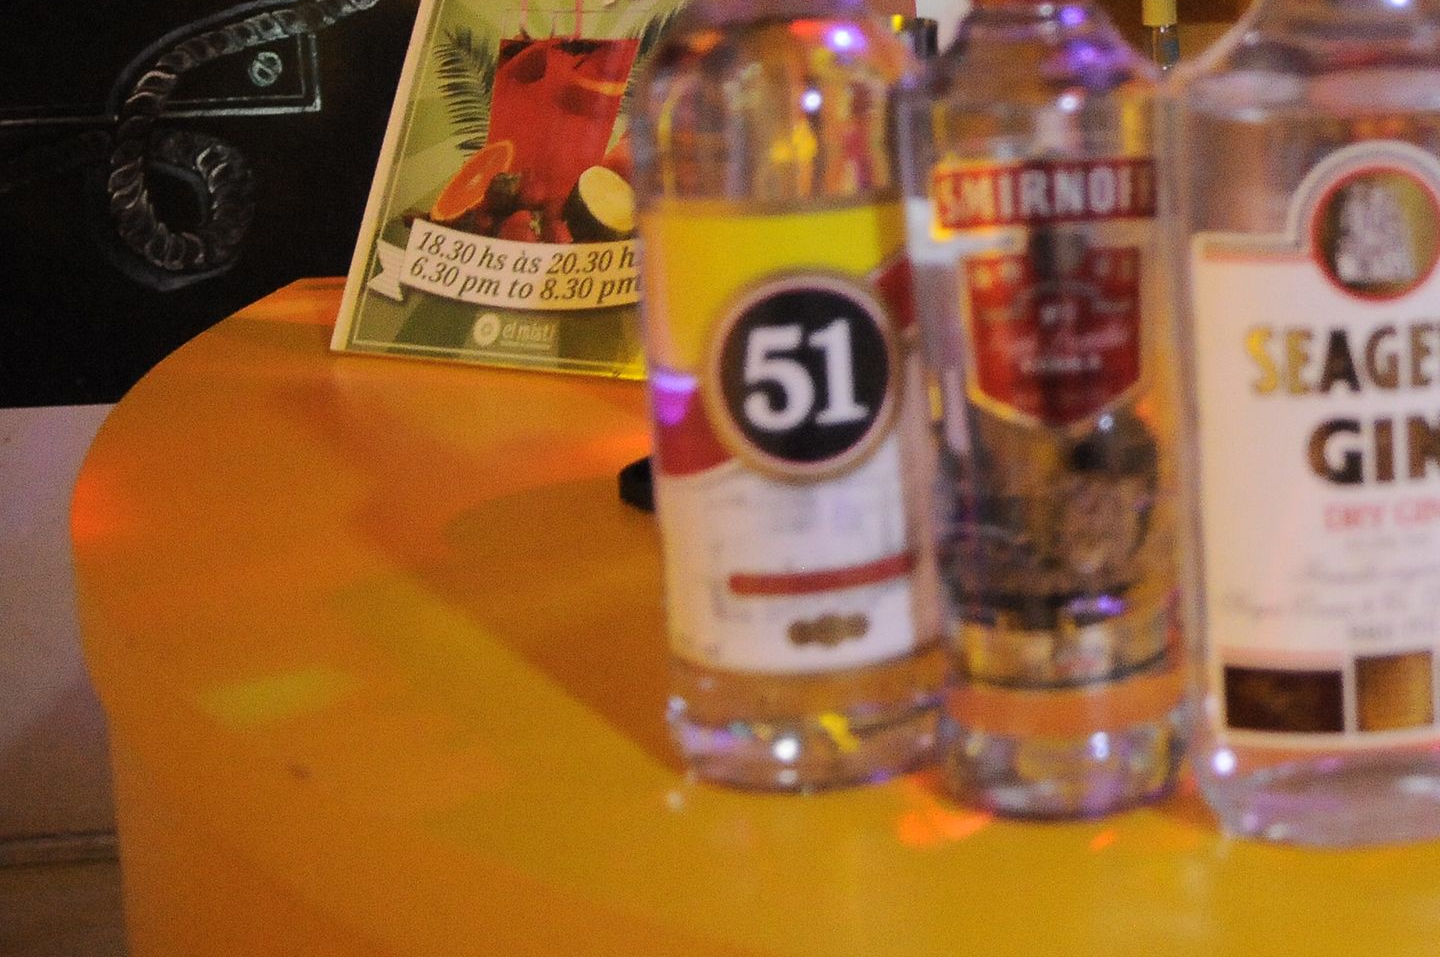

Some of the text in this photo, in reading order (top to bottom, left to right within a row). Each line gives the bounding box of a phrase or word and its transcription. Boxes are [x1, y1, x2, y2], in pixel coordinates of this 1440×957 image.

[416, 231, 477, 264] 18.30
[477, 245, 508, 272] hs
[512, 250, 543, 274] às
[547, 249, 613, 275] 20.30
[410, 257, 459, 287] 6.30
[458, 274, 502, 297] pm
[507, 279, 534, 299] to
[539, 275, 594, 300] 8.30
[743, 318, 869, 432] 51
